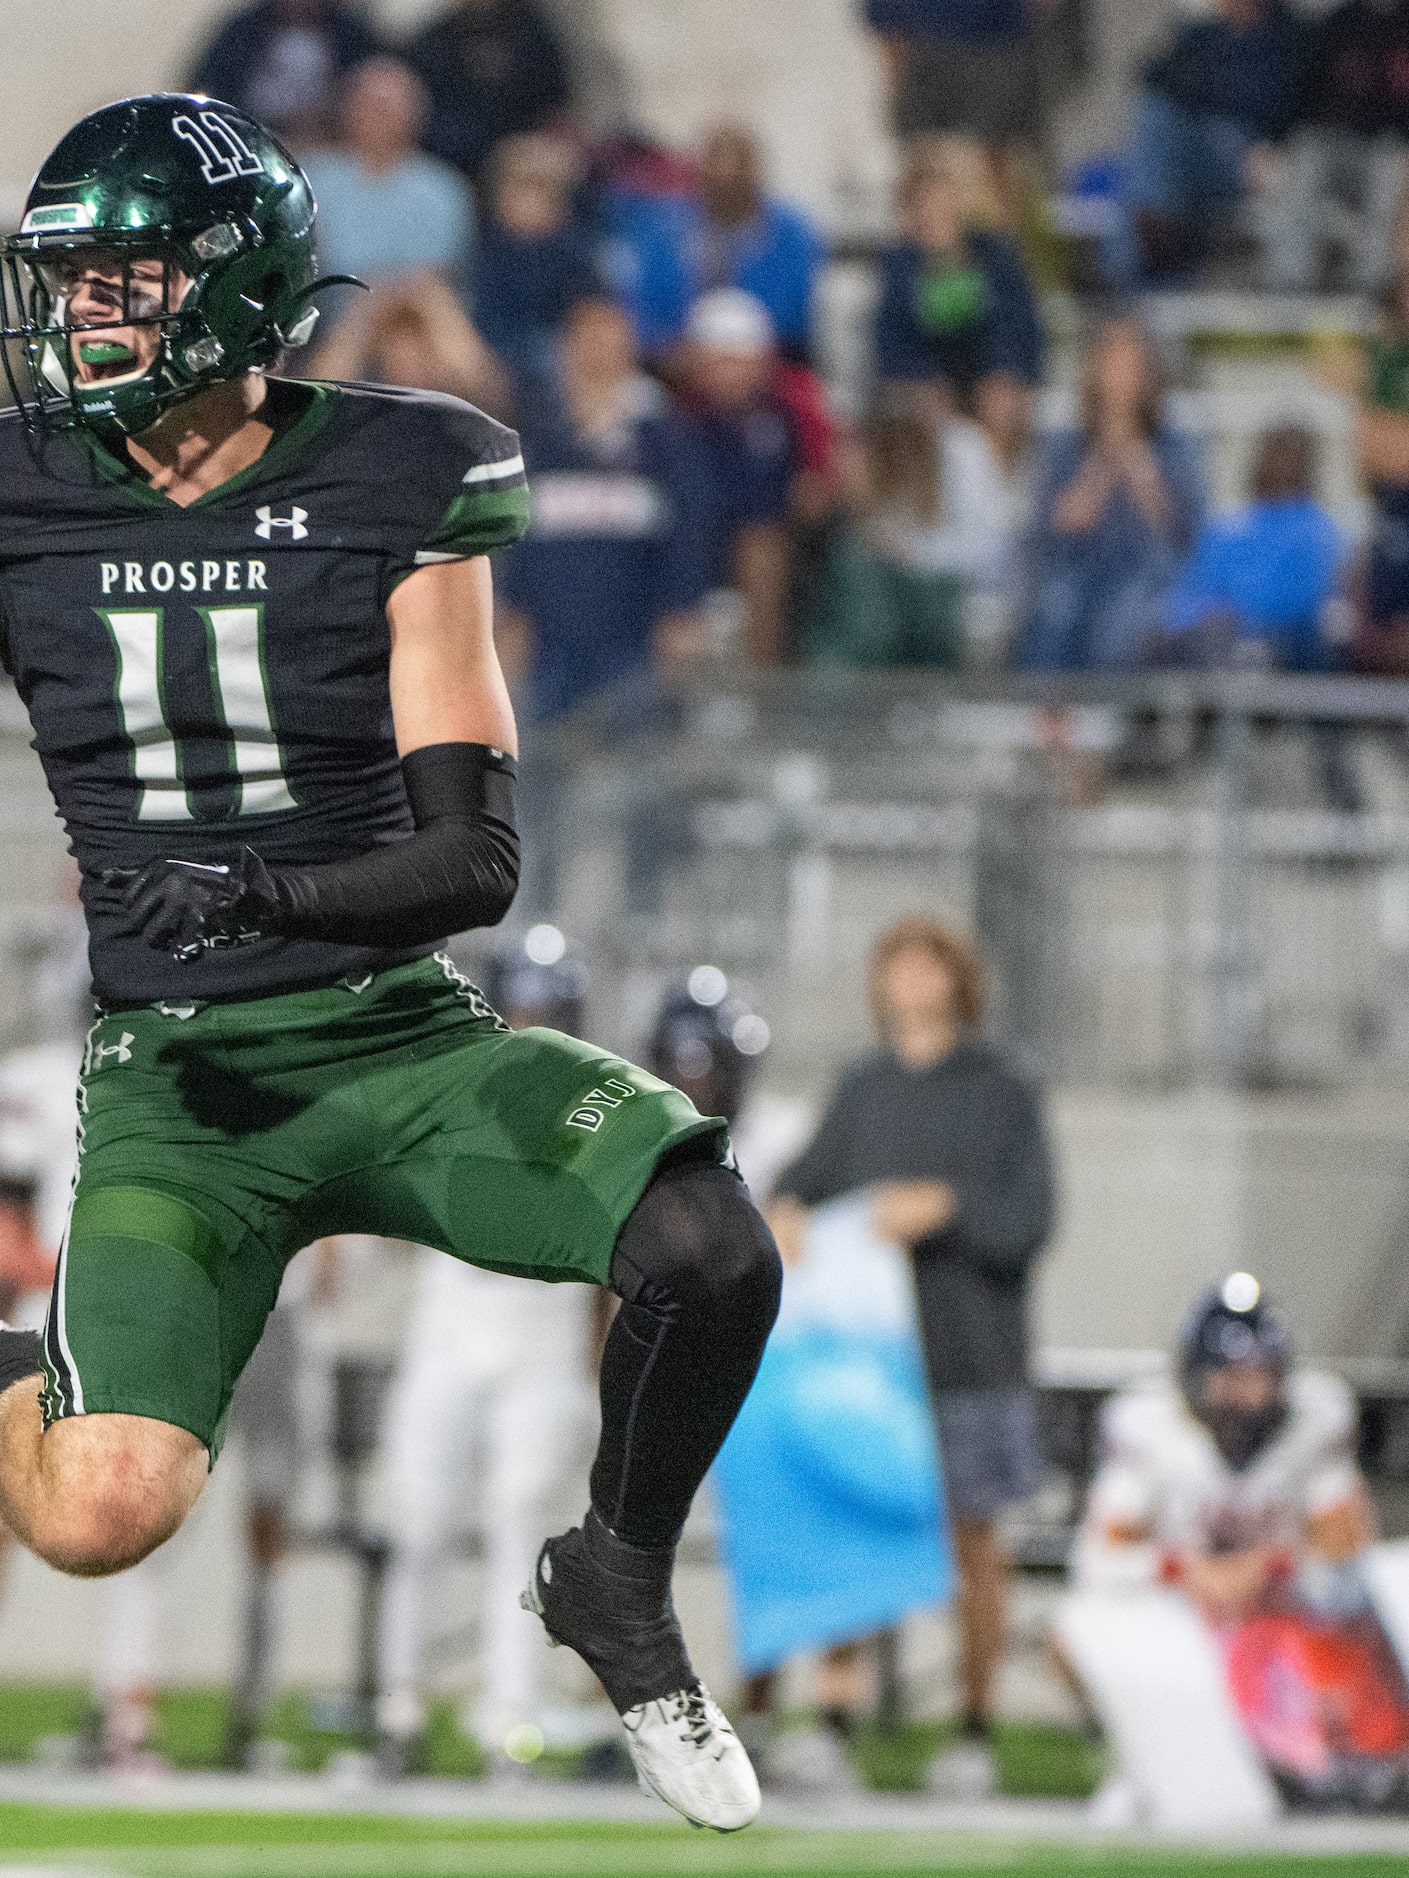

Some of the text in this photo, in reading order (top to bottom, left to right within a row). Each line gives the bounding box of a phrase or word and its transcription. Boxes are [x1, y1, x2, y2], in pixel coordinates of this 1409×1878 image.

[171, 111, 265, 185] 11
[100, 559, 269, 594] PROSPER
[90, 603, 300, 823] 11
[565, 1078, 636, 1133] DYJ
